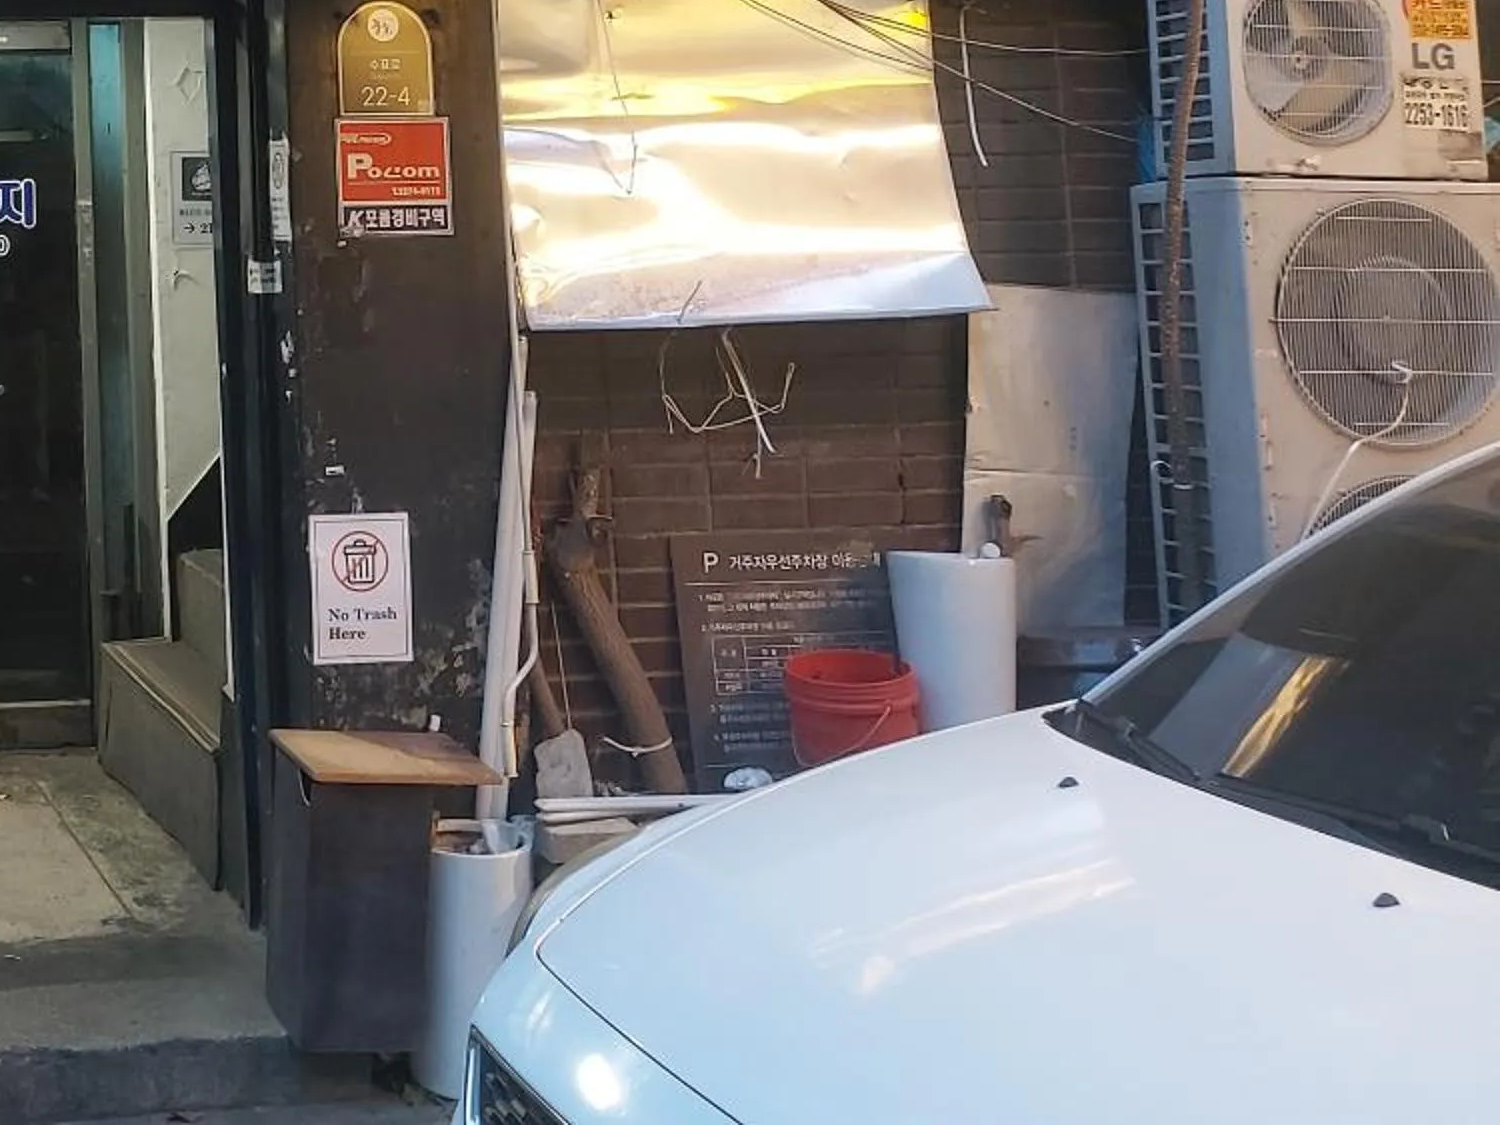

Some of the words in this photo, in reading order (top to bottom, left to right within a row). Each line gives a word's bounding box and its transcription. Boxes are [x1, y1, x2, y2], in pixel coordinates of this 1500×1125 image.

[1411, 42, 1455, 70] LG
[362, 86, 411, 106] 22-4
[328, 608, 349, 622] No
[353, 606, 397, 621] Trash
[328, 627, 366, 640] Here
